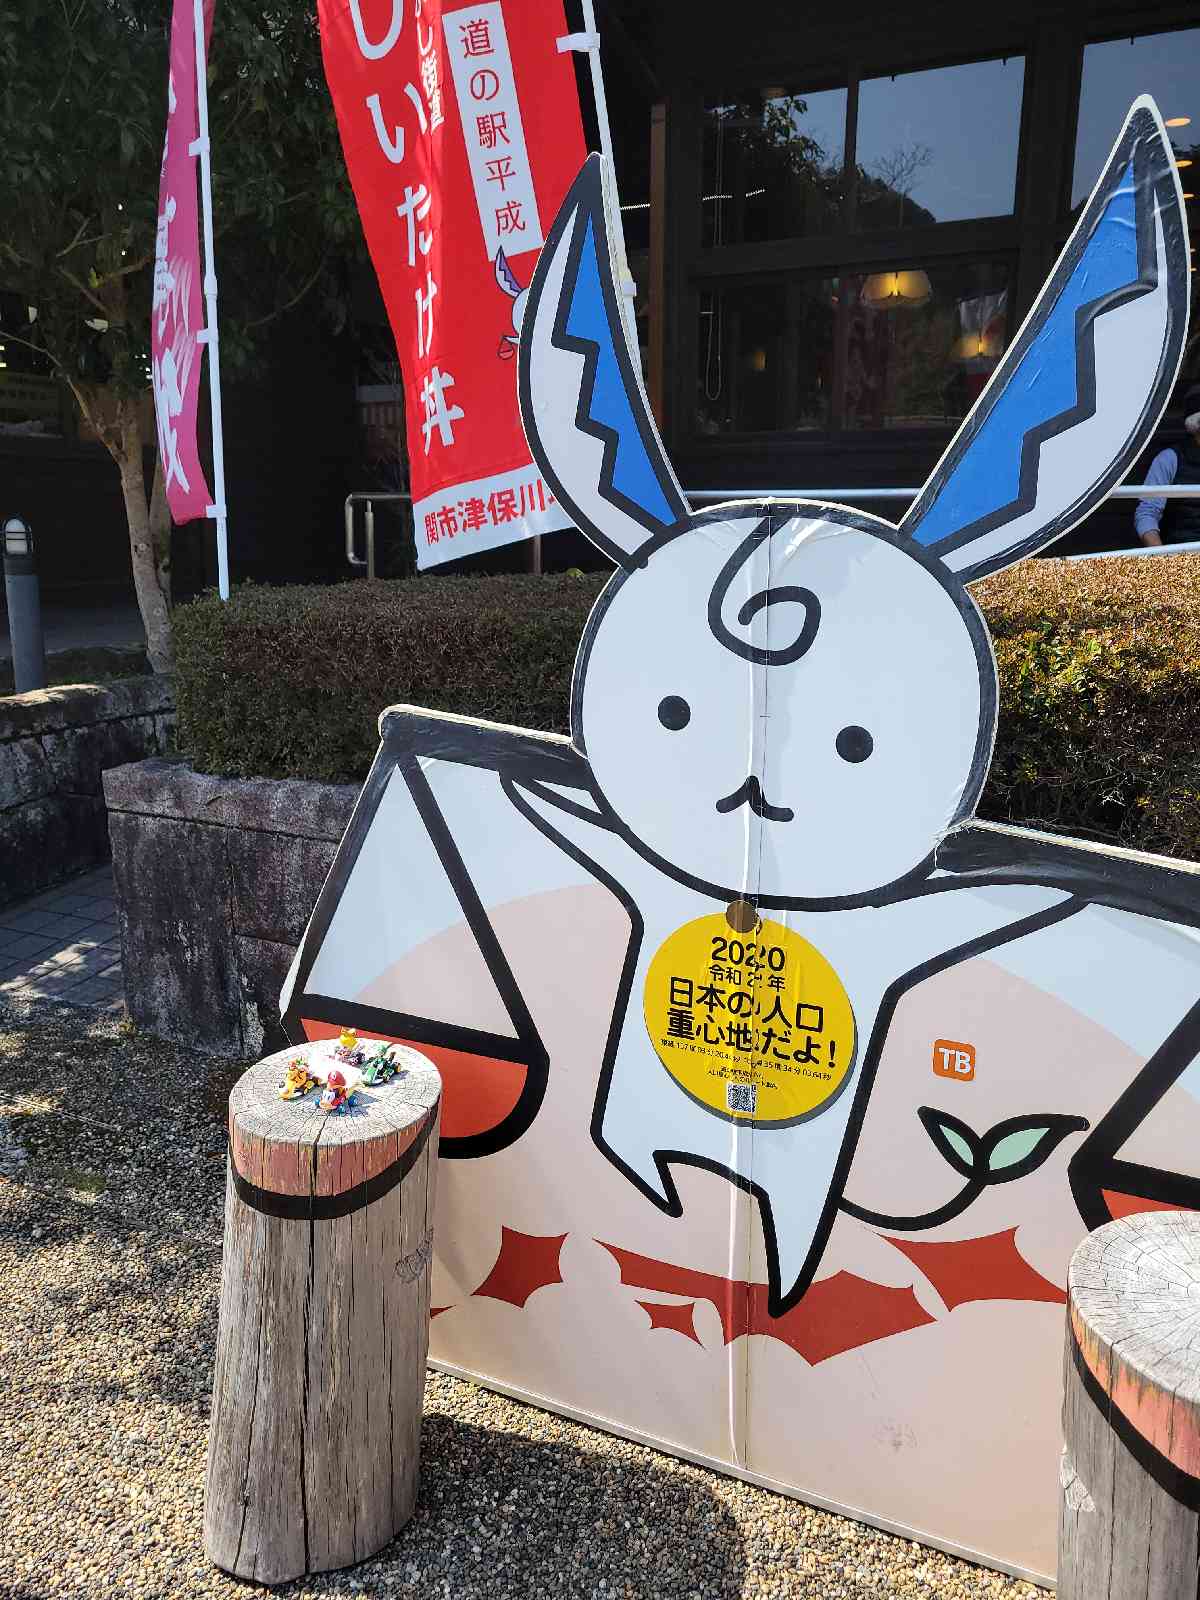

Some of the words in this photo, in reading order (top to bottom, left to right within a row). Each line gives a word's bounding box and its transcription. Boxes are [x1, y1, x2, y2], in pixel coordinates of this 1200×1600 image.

[458, 18, 527, 237] 道の駅平成
[424, 479, 556, 546] 関市津保川
[711, 936, 786, 972] 2020
[669, 976, 824, 1034] 日本の人口
[938, 1047, 971, 1074] TB
